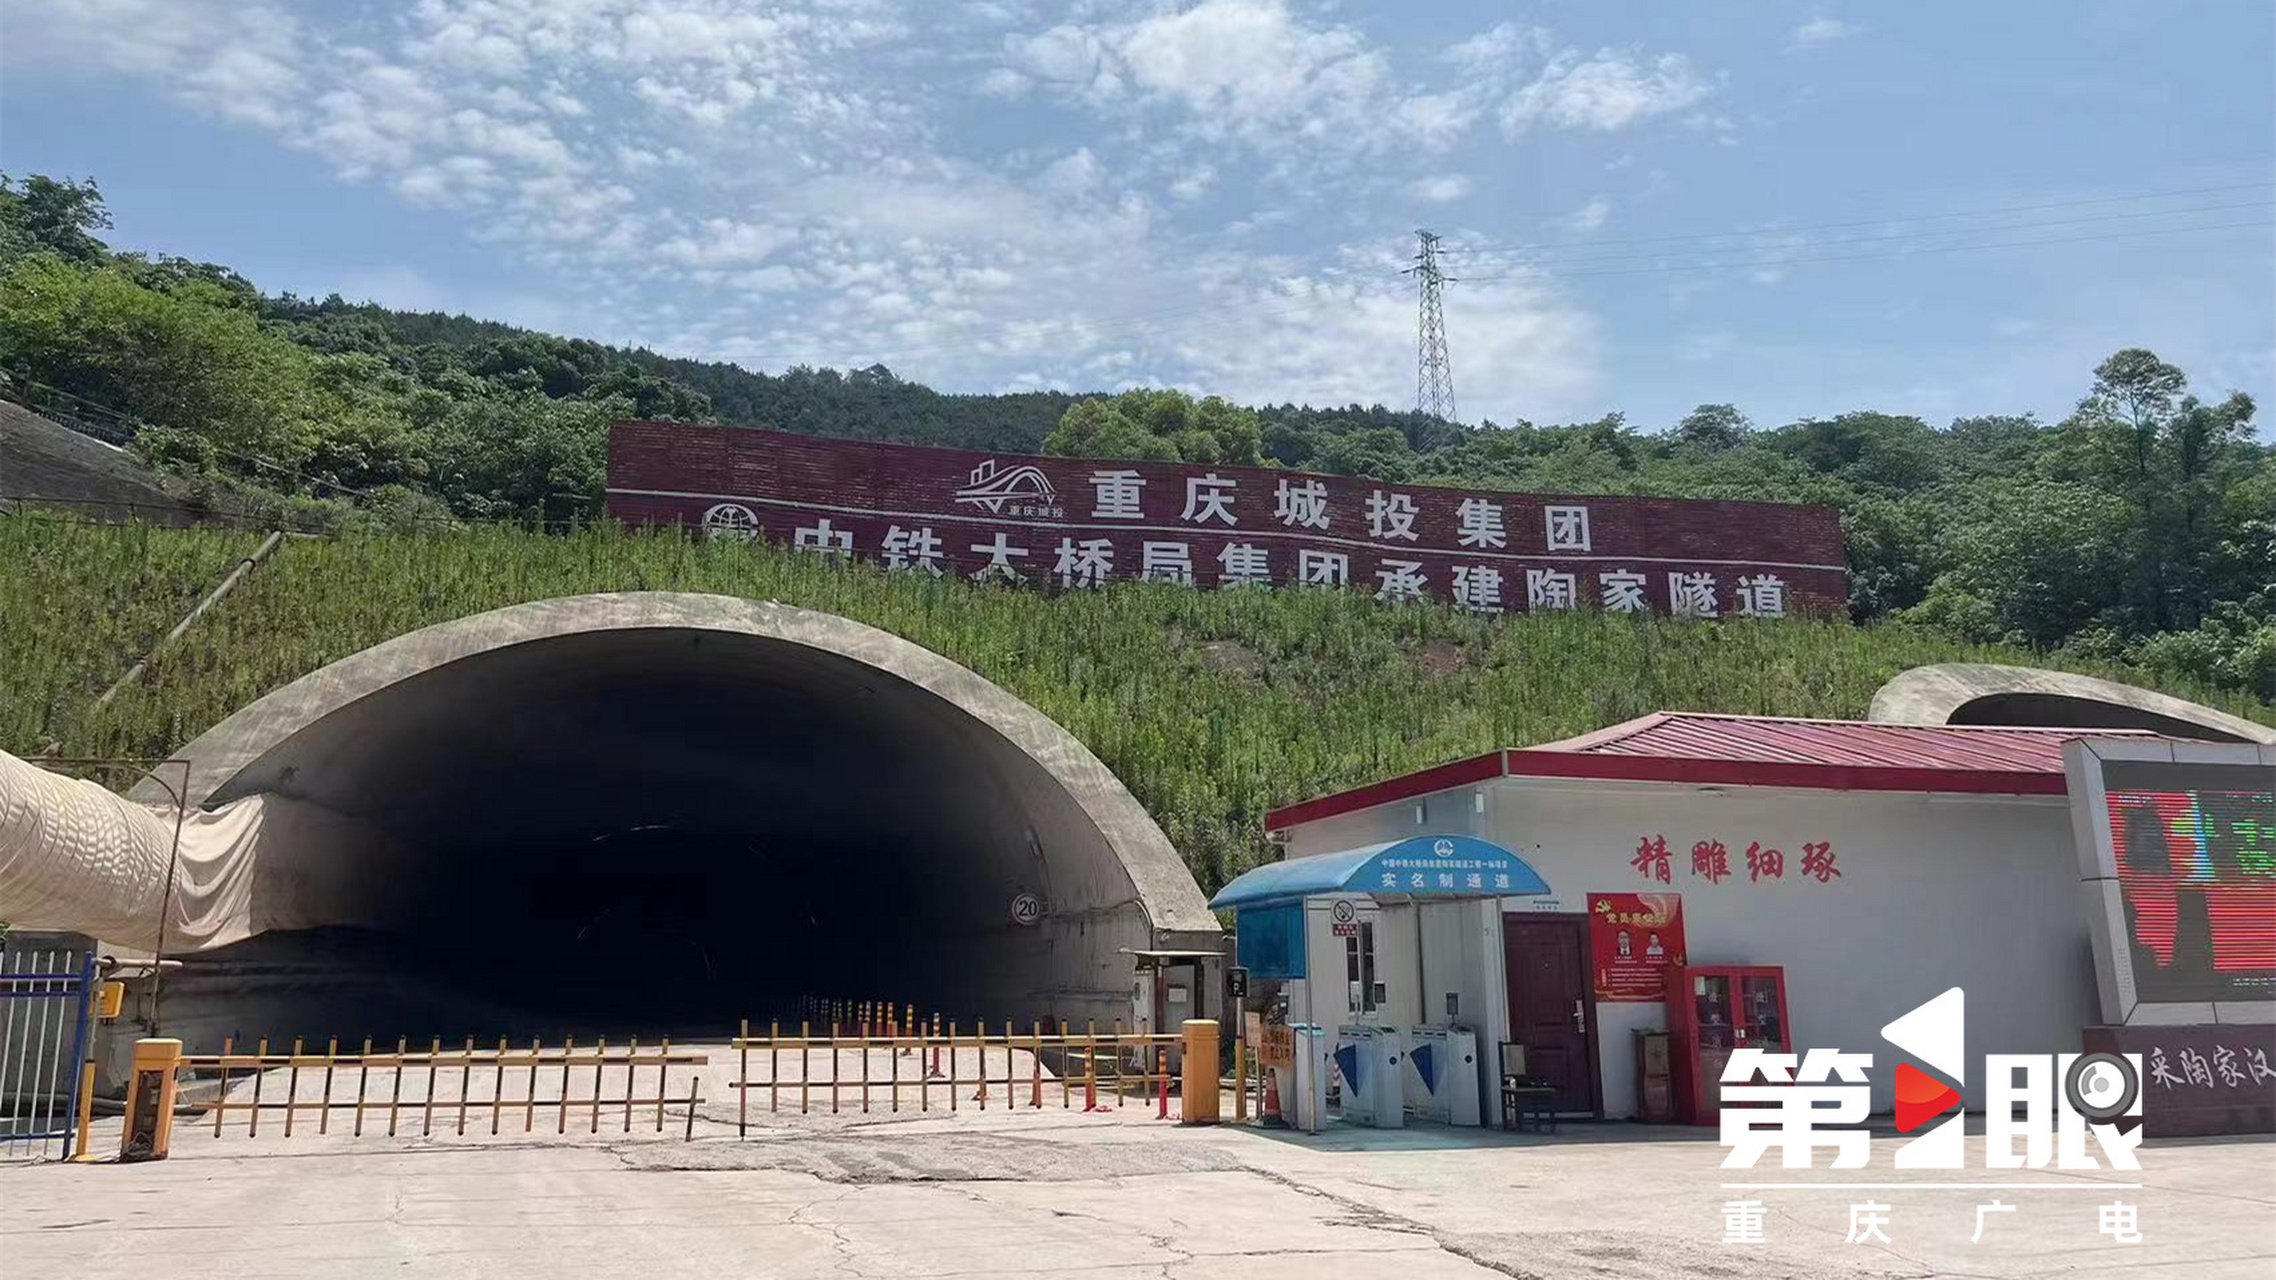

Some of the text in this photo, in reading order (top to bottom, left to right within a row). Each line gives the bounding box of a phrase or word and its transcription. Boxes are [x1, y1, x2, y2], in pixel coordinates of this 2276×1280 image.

[1008, 505, 1064, 519] 重庆城投
[1090, 470, 1593, 551] 重庆城投集团
[794, 518, 1786, 618] 中铁大桥局集团承建陶家隧道
[1630, 834, 1841, 884] 精雕细琢
[1381, 872, 1509, 888] 实名制通道
[1018, 900, 1038, 917] 20
